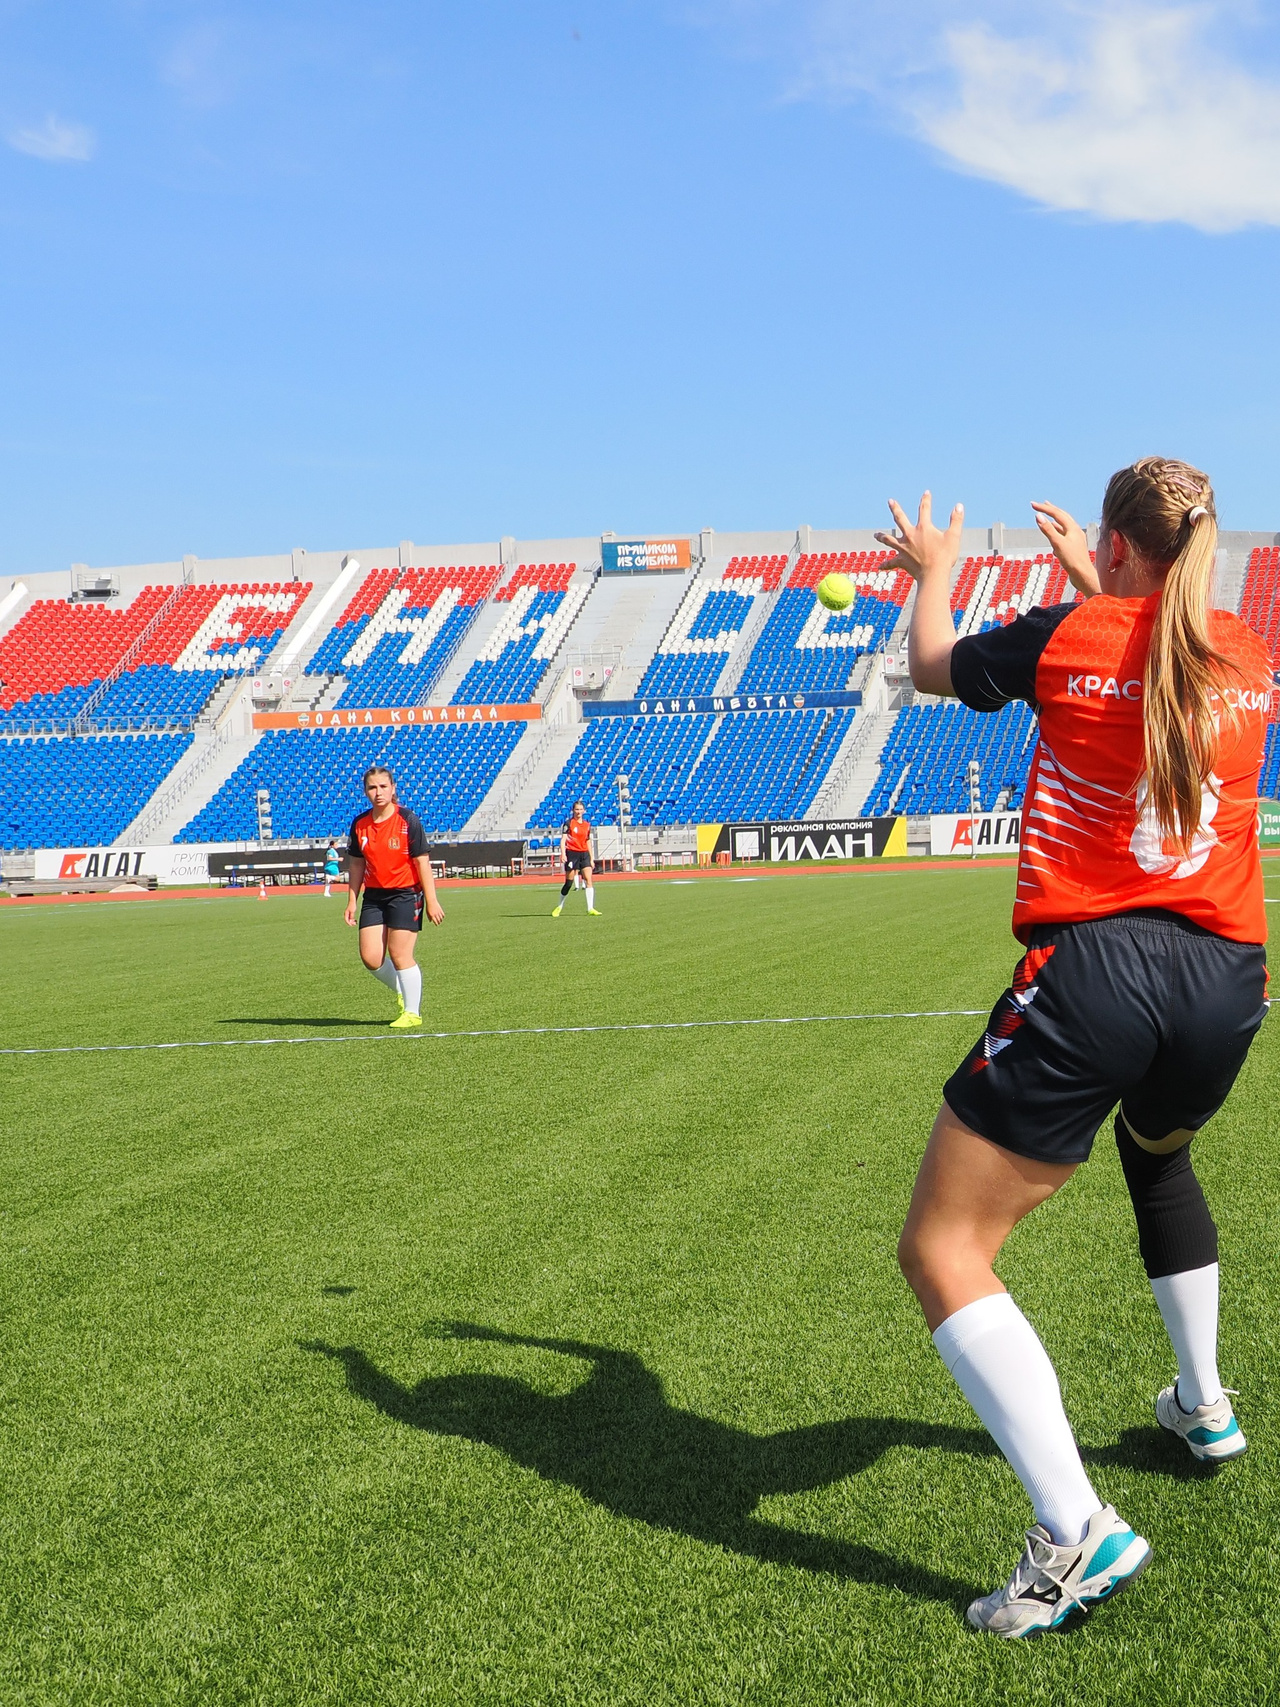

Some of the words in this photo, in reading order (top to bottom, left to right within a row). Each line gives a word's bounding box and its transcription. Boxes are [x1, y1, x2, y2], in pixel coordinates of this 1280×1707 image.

[617, 544, 677, 556] ПРЯМИКОМ
[617, 556, 633, 567] ИЗ
[634, 554, 678, 566] СИБИРИ
[639, 699, 696, 714] ОДНА
[315, 711, 373, 726] ОДНА
[390, 706, 498, 723] КОМАНДА
[770, 823, 824, 834] рекламная
[826, 821, 873, 830] компания
[977, 818, 1020, 845] АГА
[770, 833, 873, 861] ИЛАН
[85, 851, 146, 877] АГАТ
